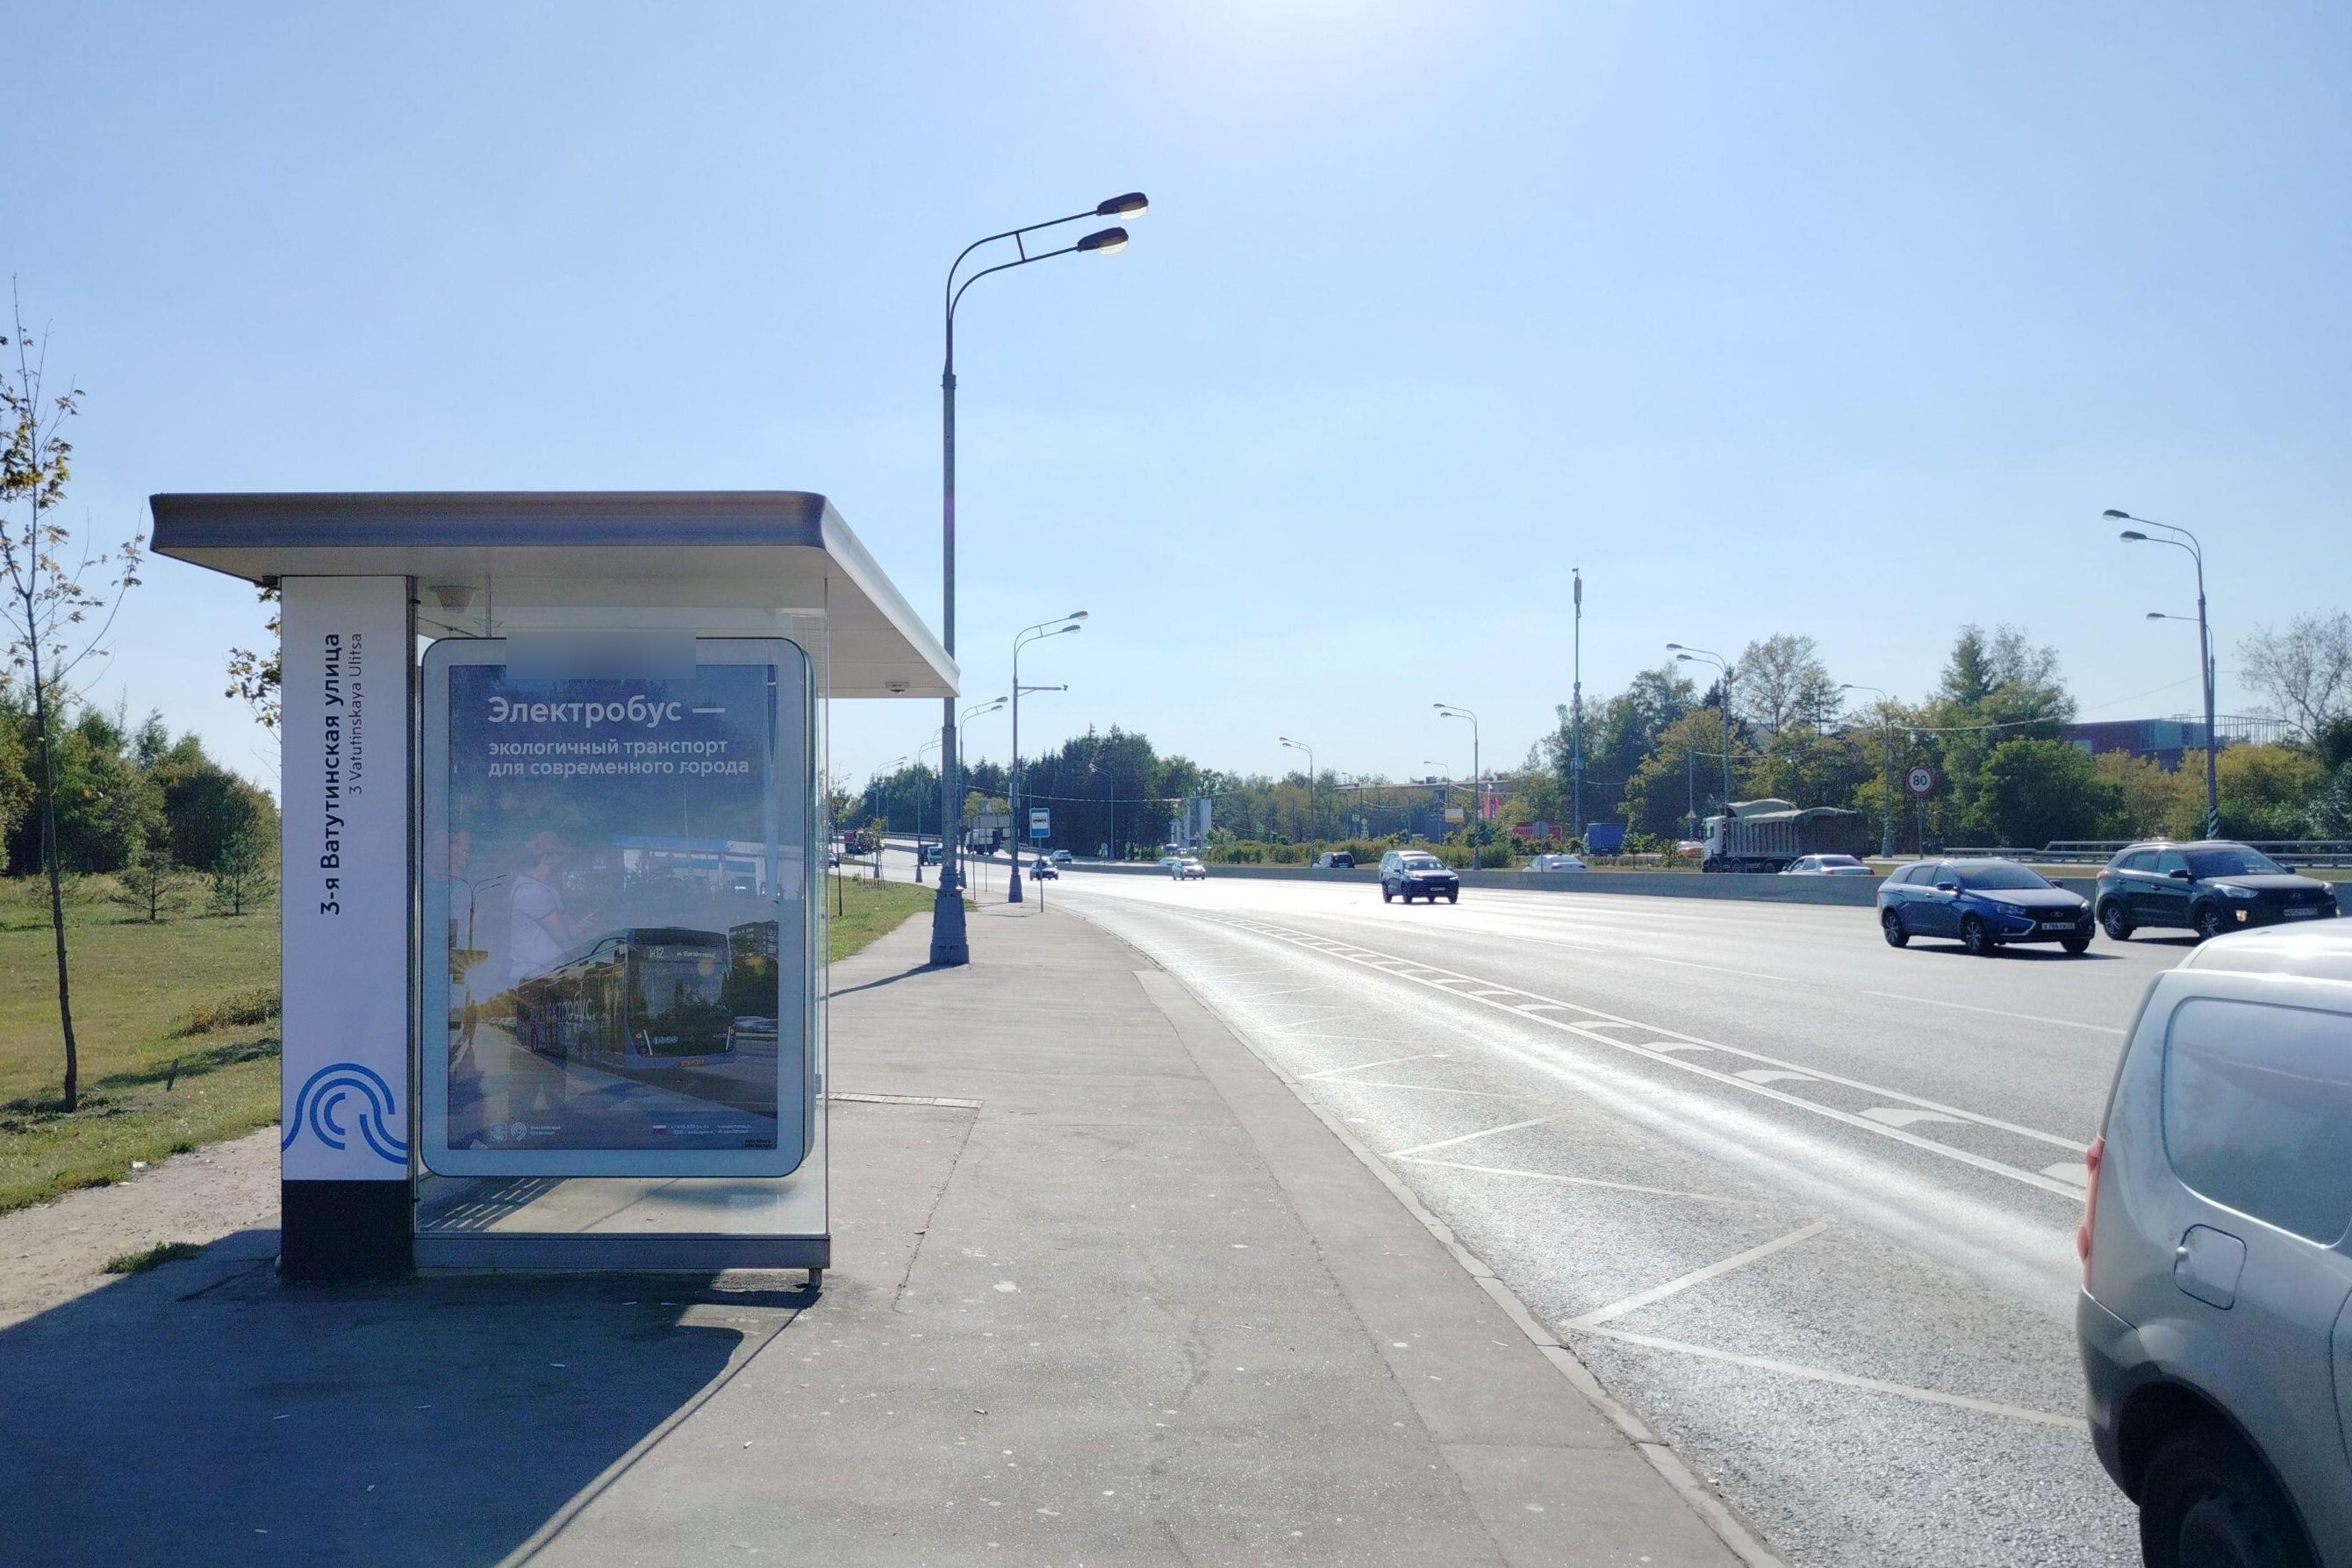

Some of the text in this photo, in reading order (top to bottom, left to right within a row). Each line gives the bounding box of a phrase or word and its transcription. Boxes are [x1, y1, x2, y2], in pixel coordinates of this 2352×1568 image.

[348, 634, 364, 795] 3 Vatutinskaya Ulitsa
[488, 695, 682, 728] Электробус
[489, 738, 728, 757] экологичный транспорт
[320, 634, 344, 915] 3-я Ватутинская улица
[488, 761, 749, 778] для современного города
[1913, 775, 1927, 786] 80
